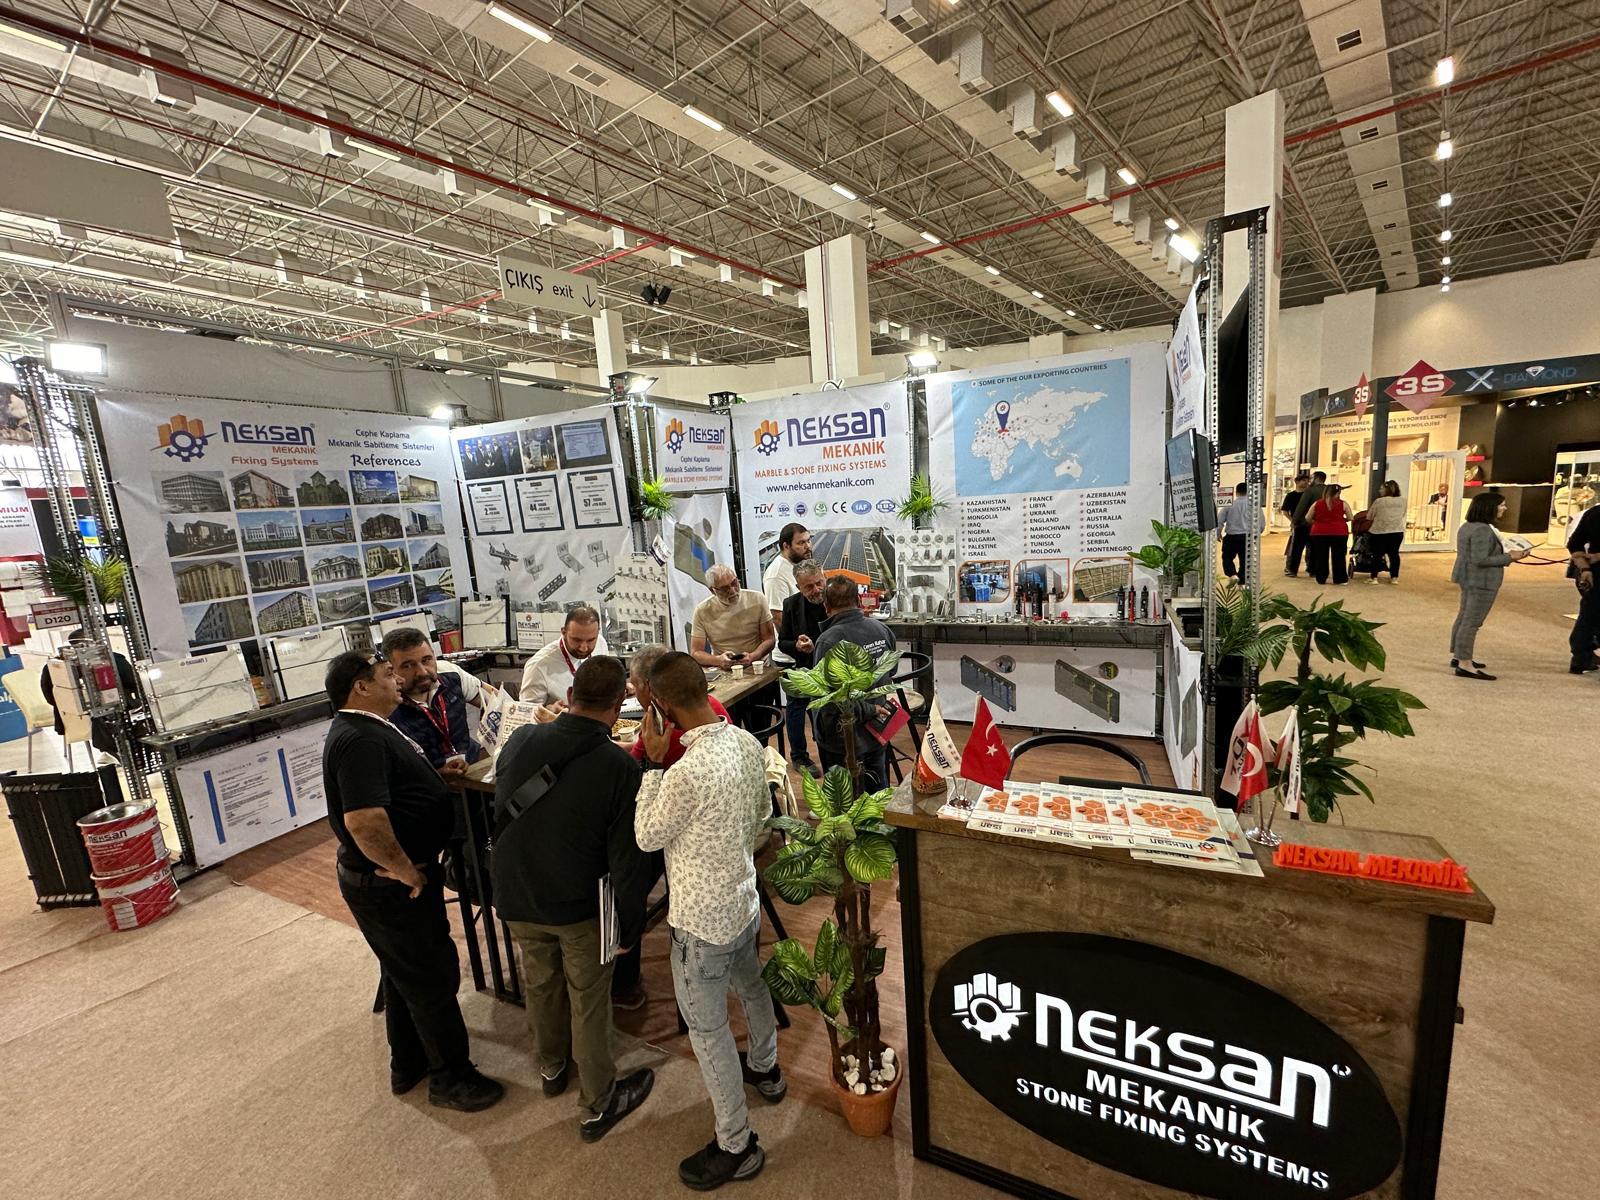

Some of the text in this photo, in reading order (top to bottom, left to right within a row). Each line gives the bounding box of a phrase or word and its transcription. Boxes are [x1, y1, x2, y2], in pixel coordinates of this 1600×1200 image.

[505, 268, 574, 298] ÇIKIŞ exit
[978, 378, 996, 387] SOME
[1034, 369, 1069, 380] EXPORTING
[1070, 364, 1107, 374] COUNTRIES
[1396, 374, 1444, 396] 3S
[1354, 386, 1369, 404] 3S
[356, 429, 410, 439] Cephe Kaplama
[328, 439, 434, 451] Mekanik Sabitleme Sistemleri
[822, 438, 885, 460] MEKANİK
[232, 456, 319, 466] Fixing Systems
[350, 454, 421, 468] References
[754, 460, 887, 478] MARBLE & STONE FIXING SYSTEMS
[766, 478, 874, 493] www.neksanmekanik.com
[45, 615, 71, 624] D120
[1278, 842, 1469, 889] NEKSAN MEKANİK
[1086, 1068, 1268, 1144] MEKANİK
[1016, 1076, 1330, 1191] STONE FIXING SYSTEMS
